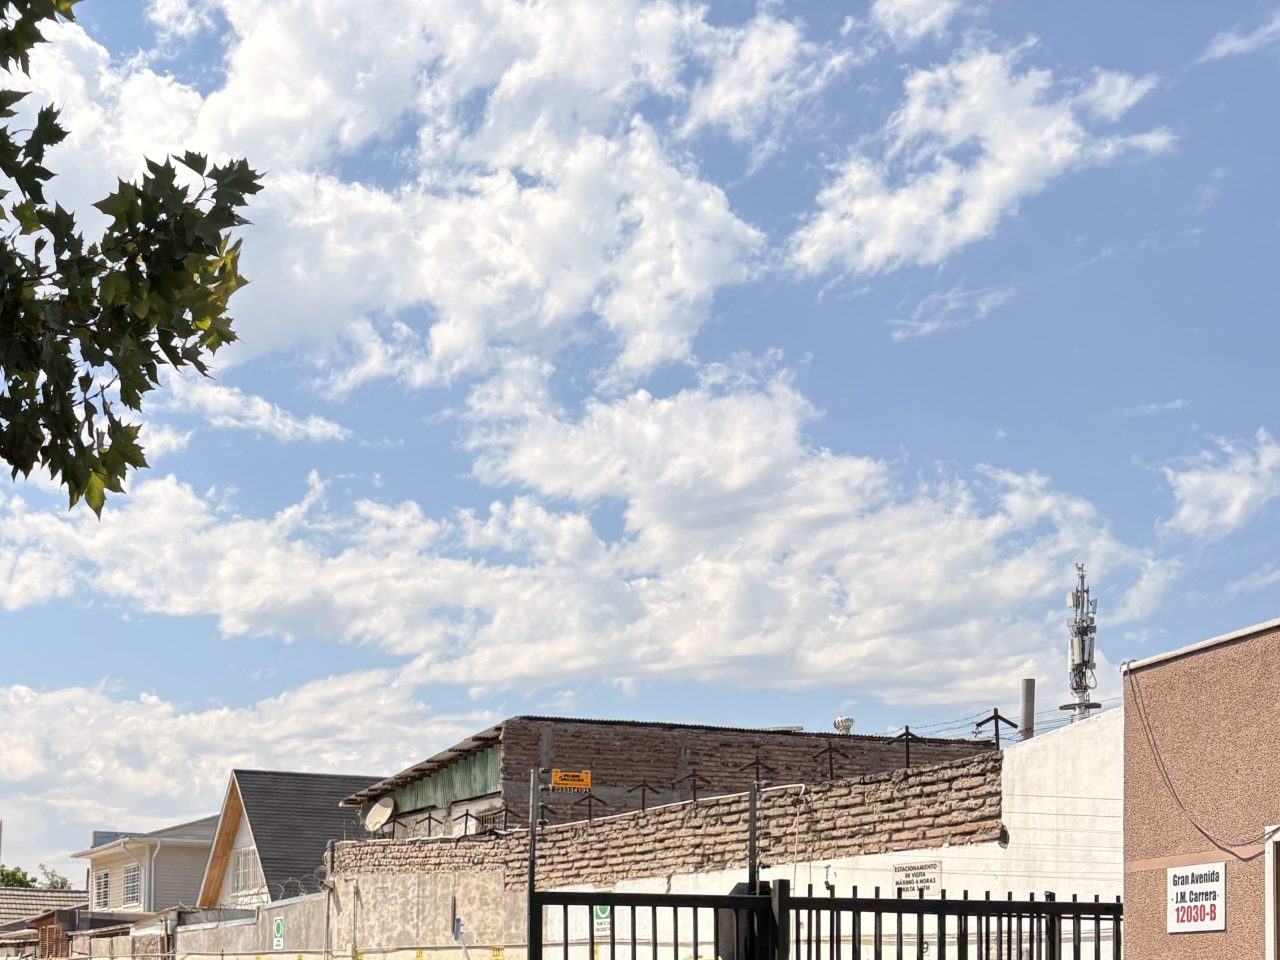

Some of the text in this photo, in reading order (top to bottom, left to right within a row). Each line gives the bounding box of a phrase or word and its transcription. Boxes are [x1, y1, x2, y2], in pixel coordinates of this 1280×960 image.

[1173, 870, 1220, 886] Gran Avenida
[1175, 890, 1217, 904] J.M. Carrera
[1175, 903, 1217, 924] 12030-B
